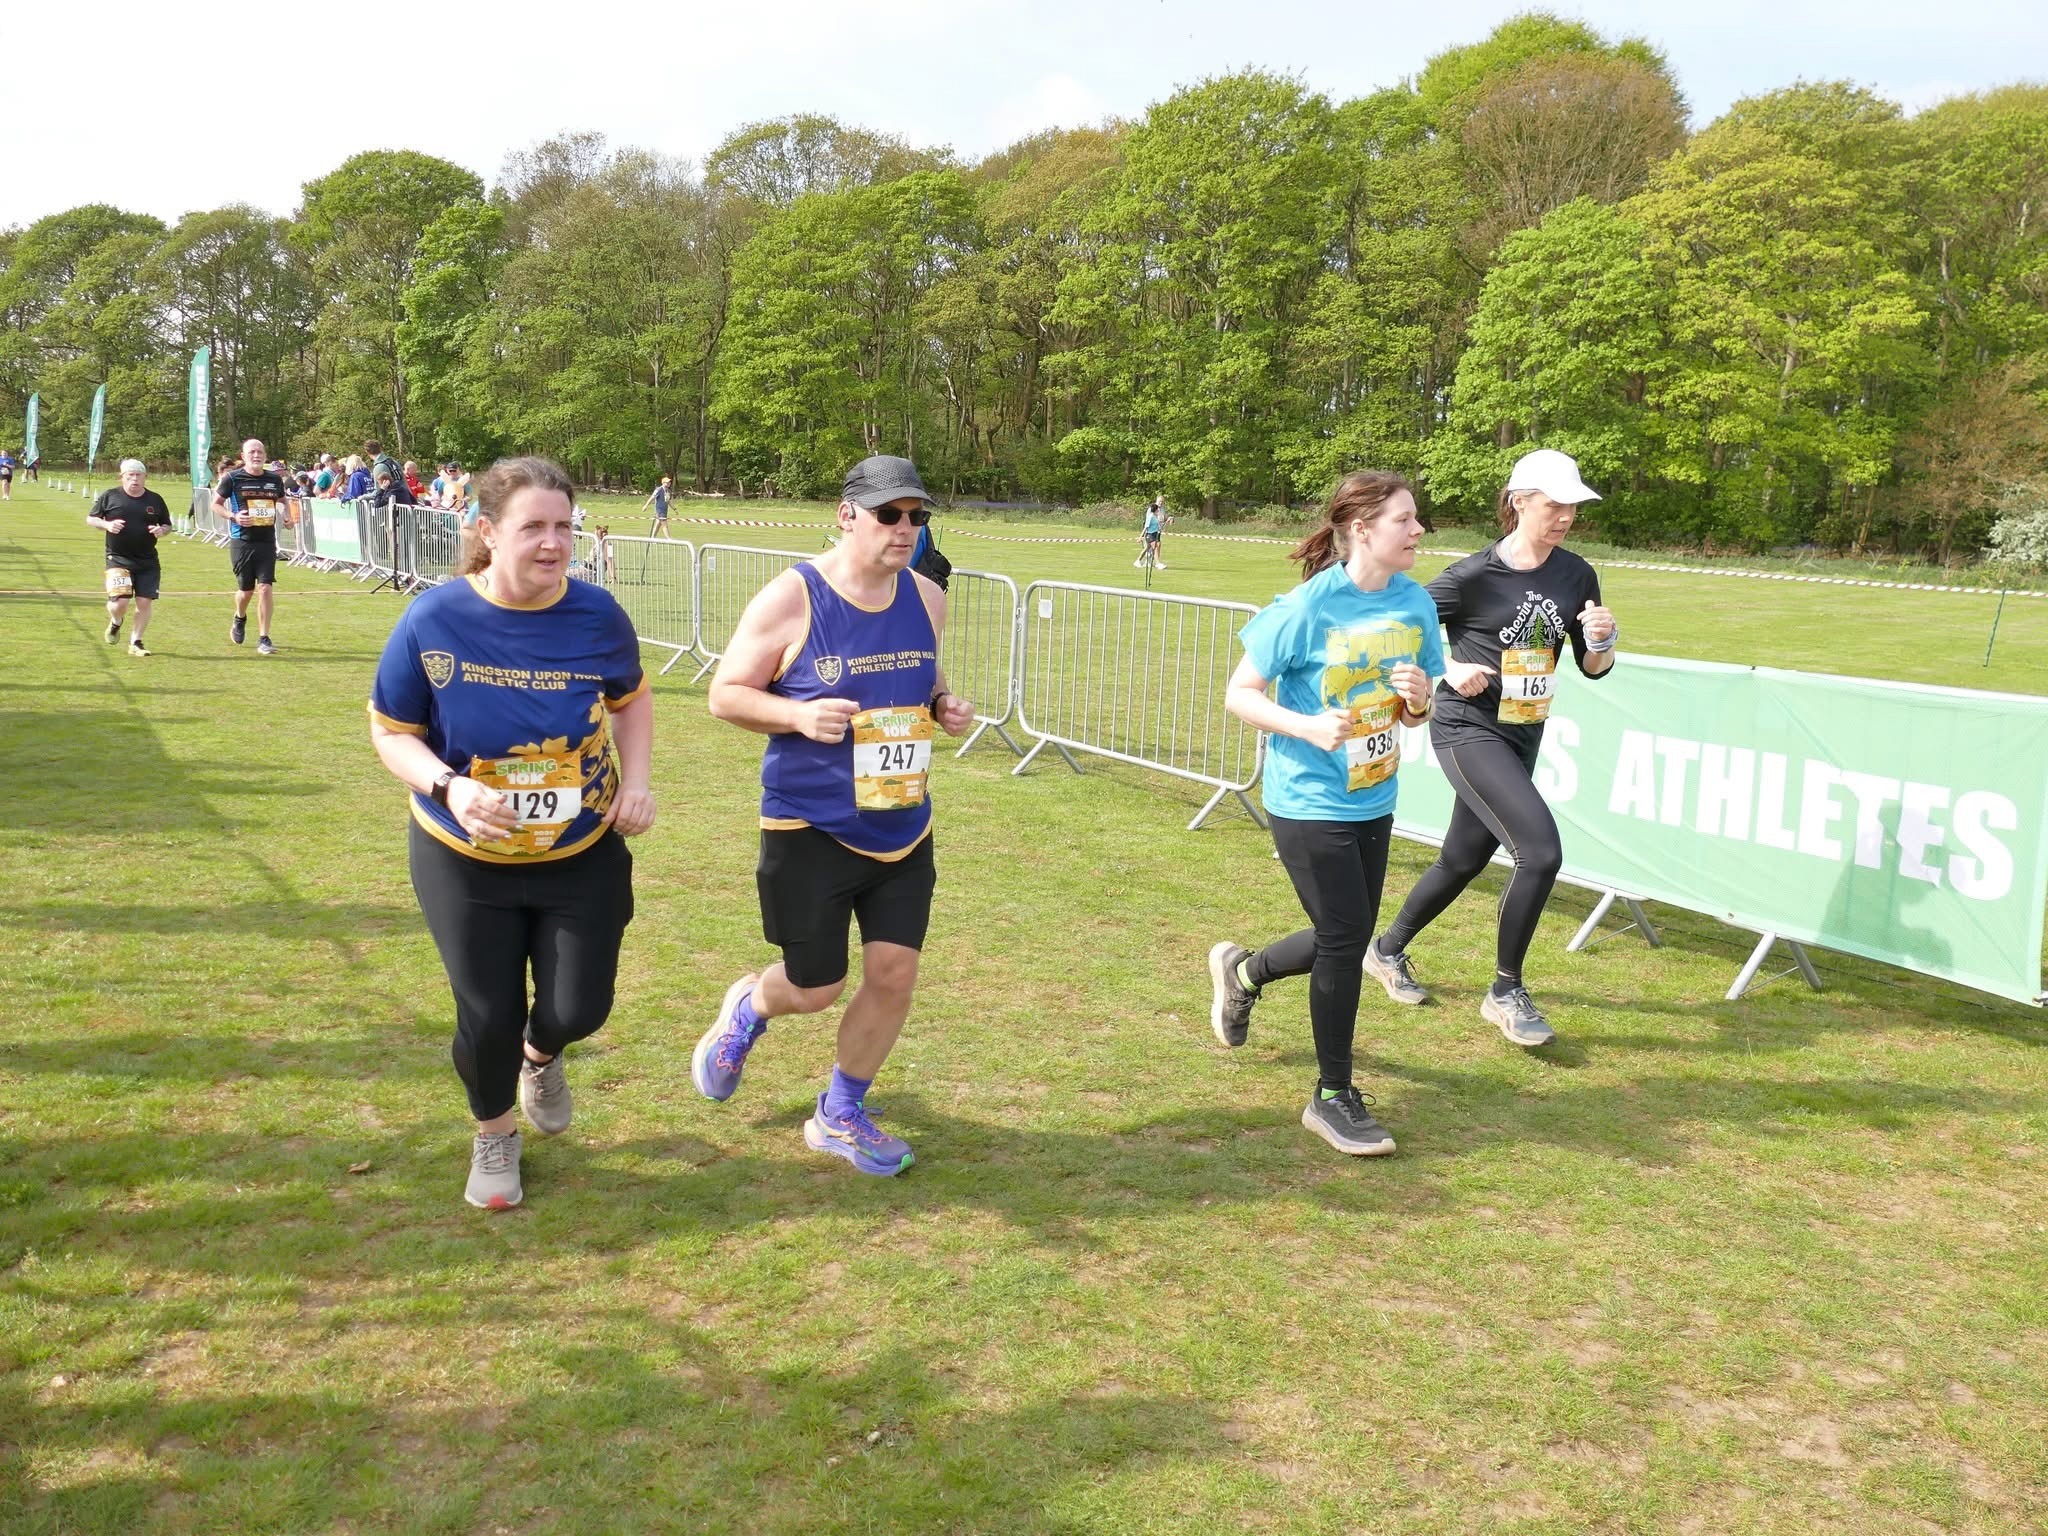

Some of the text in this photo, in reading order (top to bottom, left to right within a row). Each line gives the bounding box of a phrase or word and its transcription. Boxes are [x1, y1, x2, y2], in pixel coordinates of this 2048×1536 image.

[1526, 591, 1543, 601] The
[1499, 602, 1532, 644] Chevin
[1542, 599, 1566, 639] Chase
[848, 653, 896, 667] KINGSTON
[897, 651, 922, 660] UPON
[851, 660, 921, 675] ATHLETIC CLUB
[461, 662, 531, 680] KINGSTON
[534, 671, 571, 680] UPON
[463, 673, 567, 690] ATHLETIC CLUB
[1523, 677, 1547, 696] 163
[873, 712, 918, 728] SPRING
[1370, 716, 1393, 730] 10K
[883, 724, 912, 737] 10K
[1366, 729, 1393, 759] 938
[878, 743, 915, 771] 247
[495, 759, 558, 776] SPRING
[507, 773, 546, 785] 10K
[513, 791, 558, 819] 129
[1608, 729, 2017, 901] ATHLETES
